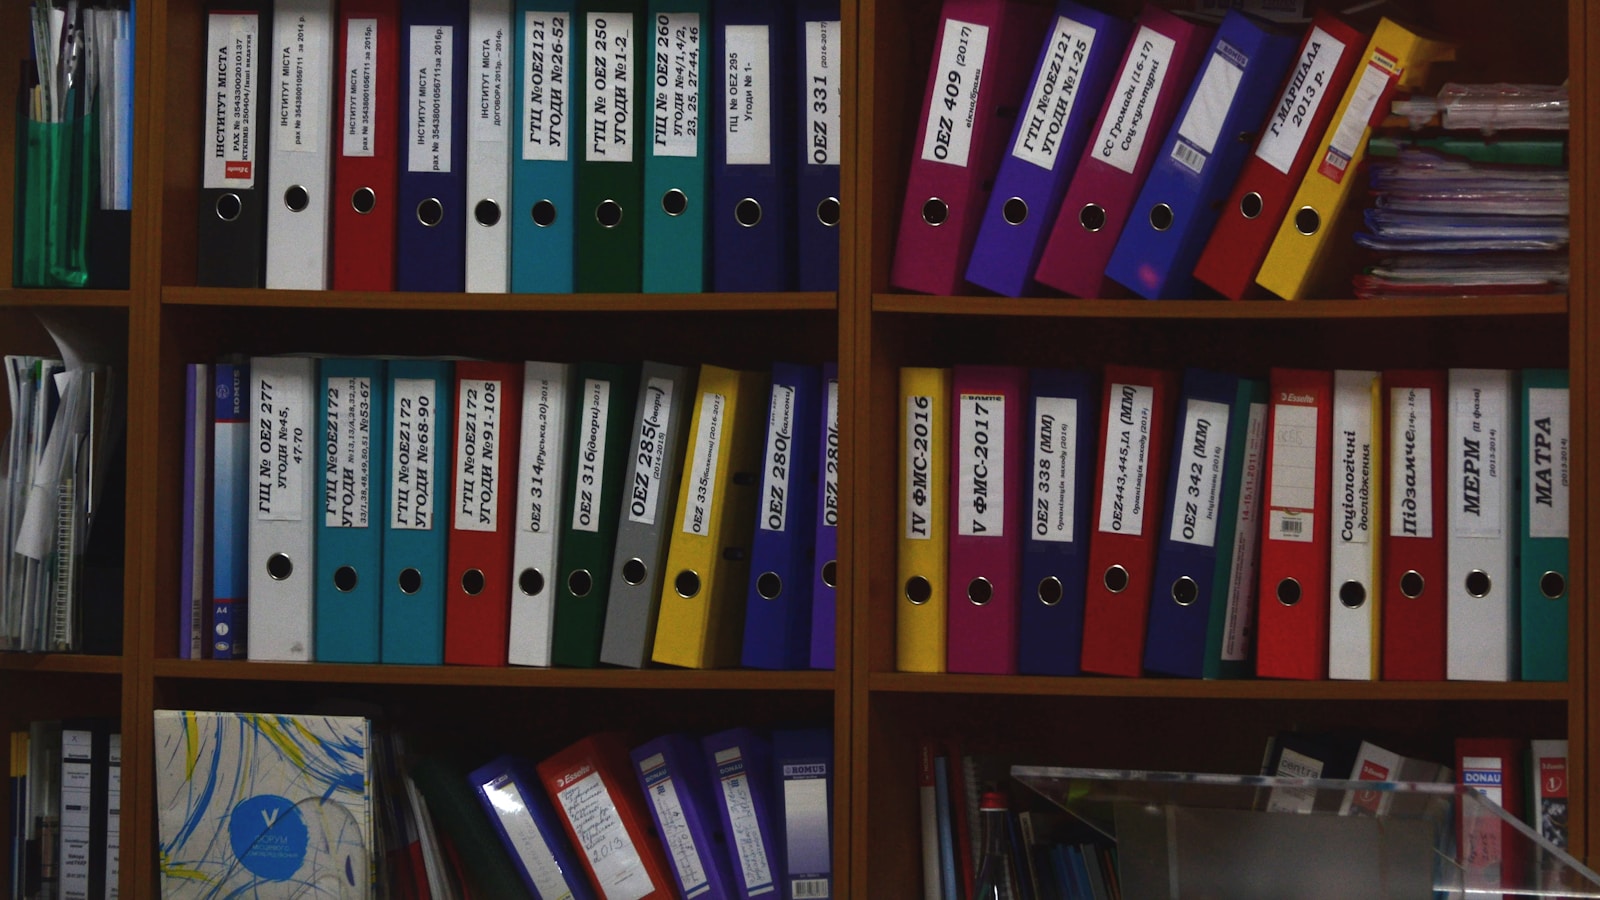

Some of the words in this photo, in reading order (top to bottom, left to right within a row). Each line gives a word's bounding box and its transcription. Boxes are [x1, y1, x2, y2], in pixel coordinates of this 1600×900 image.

[434, 26, 442, 56] 2016р.
[550, 16, 564, 84] №26-52
[595, 18, 606, 50] 250
[658, 14, 670, 48] 260
[689, 26, 698, 44] 46
[218, 46, 228, 88] МІСТА
[234, 38, 242, 118] 35433002010137
[594, 56, 606, 90] OEZ
[656, 52, 668, 87] OEZ
[688, 48, 698, 88] 27-44,
[730, 52, 738, 70] 295
[362, 126, 368, 135] №
[366, 51, 370, 60] за
[418, 67, 426, 96] МІСТА
[481, 73, 489, 119] ІНСТИТУТ
[730, 73, 738, 96] OEZ
[744, 76, 752, 88] №
[813, 75, 828, 114] 331
[934, 116, 954, 160] OEZ
[944, 70, 961, 111] 409
[956, 26, 972, 67] (2017)
[1041, 96, 1066, 156] УГОДИ
[1062, 39, 1086, 96] №1-25
[1110, 84, 1136, 139] Громади
[1131, 40, 1154, 84] (16-17)
[1270, 42, 1321, 137] Г.МАРШАЛА
[1292, 87, 1316, 128] 2013
[1314, 70, 1325, 86] р.
[280, 80, 289, 126] ІНСТИТУТ
[349, 96, 357, 135] ІНСТИТУТ
[549, 88, 563, 148] УГОДИ
[594, 96, 606, 114] №
[614, 86, 628, 146] УГОДИ
[656, 92, 667, 112] №
[674, 92, 684, 136] УГОДИ
[688, 92, 698, 112] 25,
[730, 98, 738, 110] №
[744, 90, 753, 122] Угоди
[1121, 59, 1160, 152] Соц-культурні
[215, 92, 226, 158] ІНСТИТУТ
[234, 120, 240, 130] №
[295, 120, 301, 129] №
[417, 99, 426, 145] ІНСТИТУТ
[530, 108, 544, 144] ГТЦ
[594, 120, 607, 156] ГТЦ
[688, 116, 698, 136] 23,
[1024, 114, 1043, 152] ГТЦ
[432, 142, 438, 152] №
[813, 120, 828, 164] OEZ
[261, 379, 272, 414] 277
[360, 381, 370, 433] №53-67
[260, 418, 272, 454] OEZ
[278, 406, 290, 441] №45,
[417, 395, 430, 464] №68-90
[482, 382, 495, 461] №91-108
[638, 386, 664, 468] 285(двори)
[294, 427, 302, 464] 47-70
[653, 432, 666, 480] (2014-2015)
[912, 396, 928, 507] ФМС-2016
[973, 402, 988, 514] ФМС-2017
[1212, 446, 1222, 472] (2016)
[1464, 437, 1480, 516] МЕРМ
[1472, 388, 1481, 419] фаза)
[1534, 416, 1552, 508] МАТРА
[260, 459, 271, 478] №
[278, 444, 288, 489] УГОДИ
[1038, 459, 1050, 494] 338
[1132, 465, 1144, 515] Організація
[1138, 434, 1146, 463] заходу
[1188, 462, 1202, 498] 342
[326, 479, 338, 516] ГТЦ
[342, 467, 354, 528] УГОДИ
[416, 467, 428, 528] УГОДИ
[462, 478, 475, 516] ГТЦ
[480, 464, 494, 524] УГОДИ
[631, 472, 650, 517] OEZ
[1341, 430, 1356, 542] Соціологічні
[1358, 443, 1370, 530] дослідження
[397, 488, 410, 526] ГТЦ
[530, 502, 541, 532] OEZ
[579, 490, 592, 526] OEZ
[692, 506, 704, 534] OEZ
[768, 484, 784, 530] OEZ
[912, 512, 926, 536] IV
[1036, 498, 1049, 536] OEZ
[1182, 502, 1198, 540] OEZ
[973, 519, 986, 534] V
[216, 606, 228, 614] A4
[720, 764, 743, 774] DONAU
[792, 765, 824, 774] ROMUS
[1280, 760, 1318, 778] centra
[1466, 774, 1500, 782] DONAU
[593, 837, 623, 864] 2013
